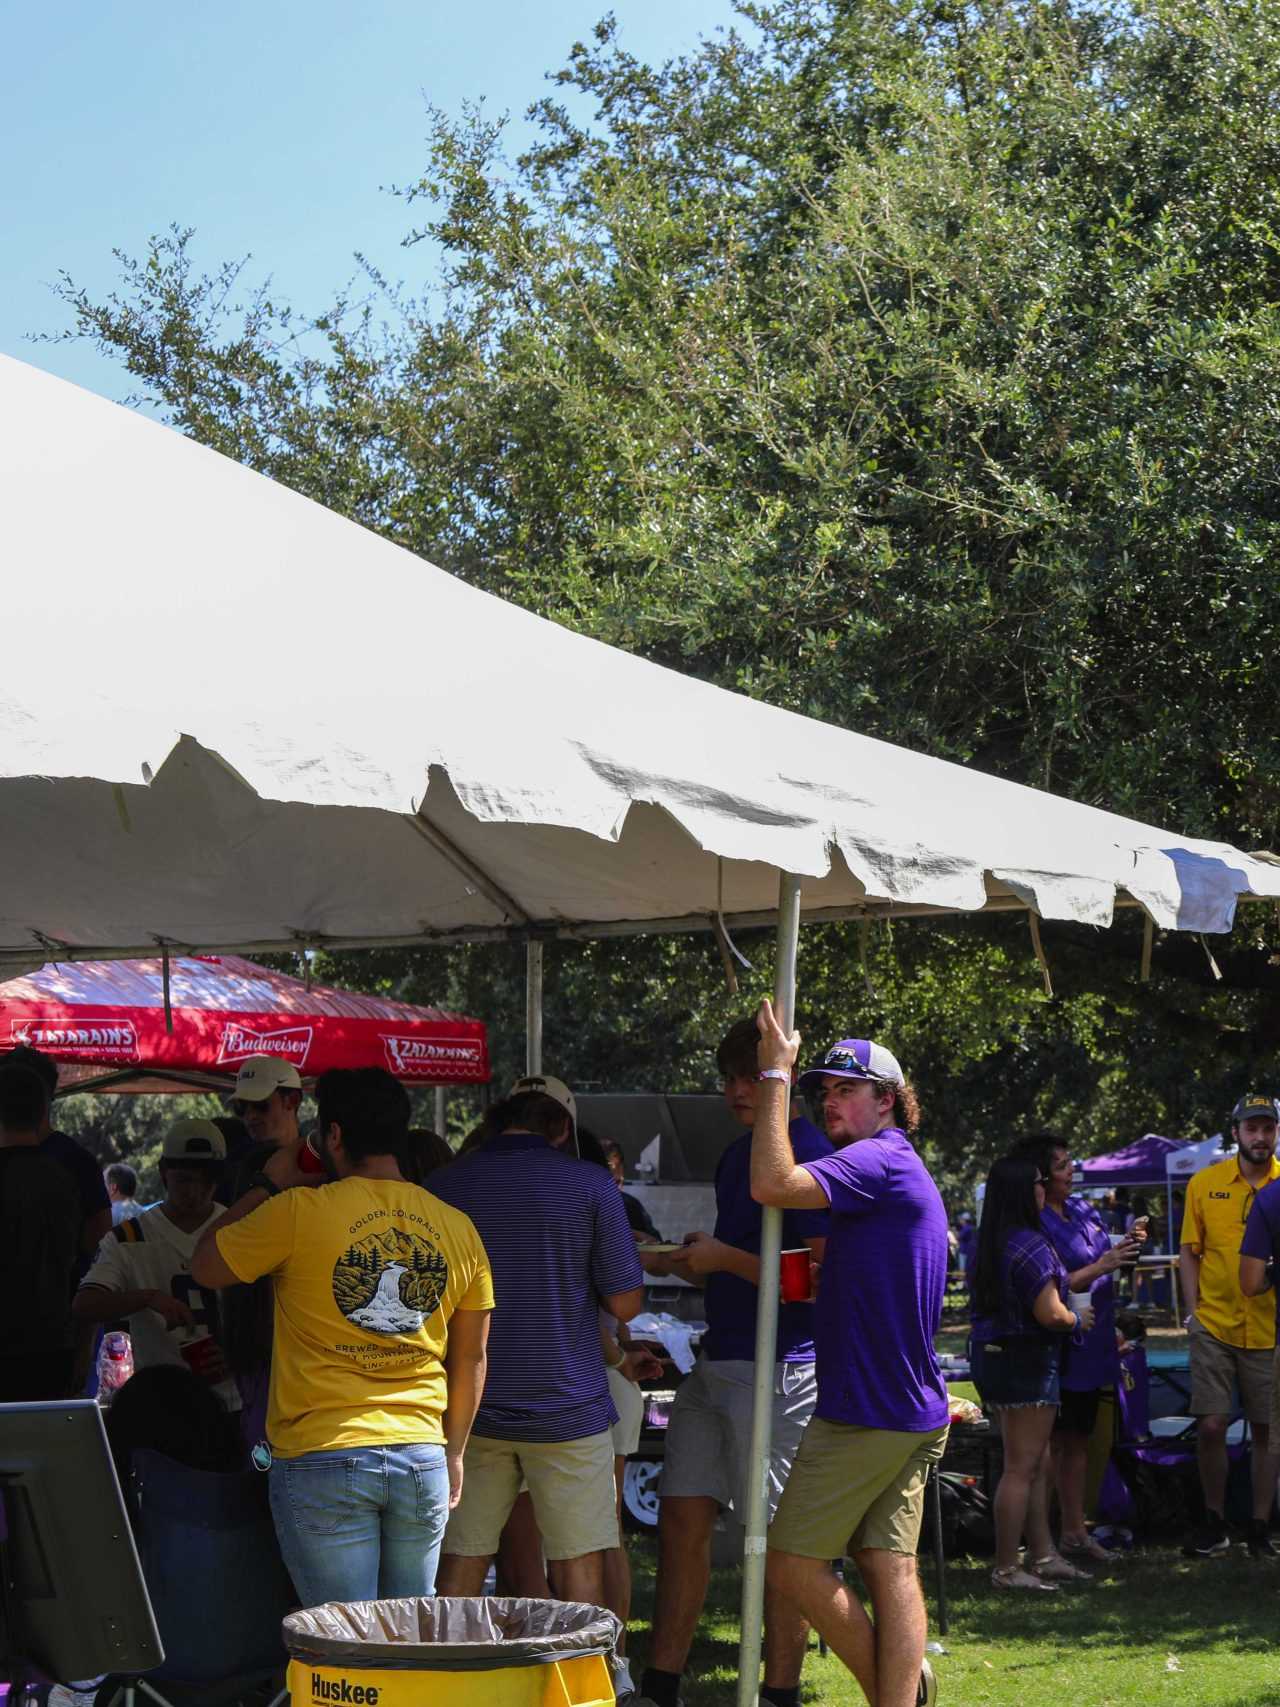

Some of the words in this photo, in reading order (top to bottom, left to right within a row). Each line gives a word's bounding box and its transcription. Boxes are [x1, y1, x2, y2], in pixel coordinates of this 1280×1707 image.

[222, 1031, 308, 1053] Budweiser
[1209, 1191, 1230, 1200] LSU
[391, 1209, 441, 1241] COLORADO
[311, 1672, 380, 1706] Huskee
